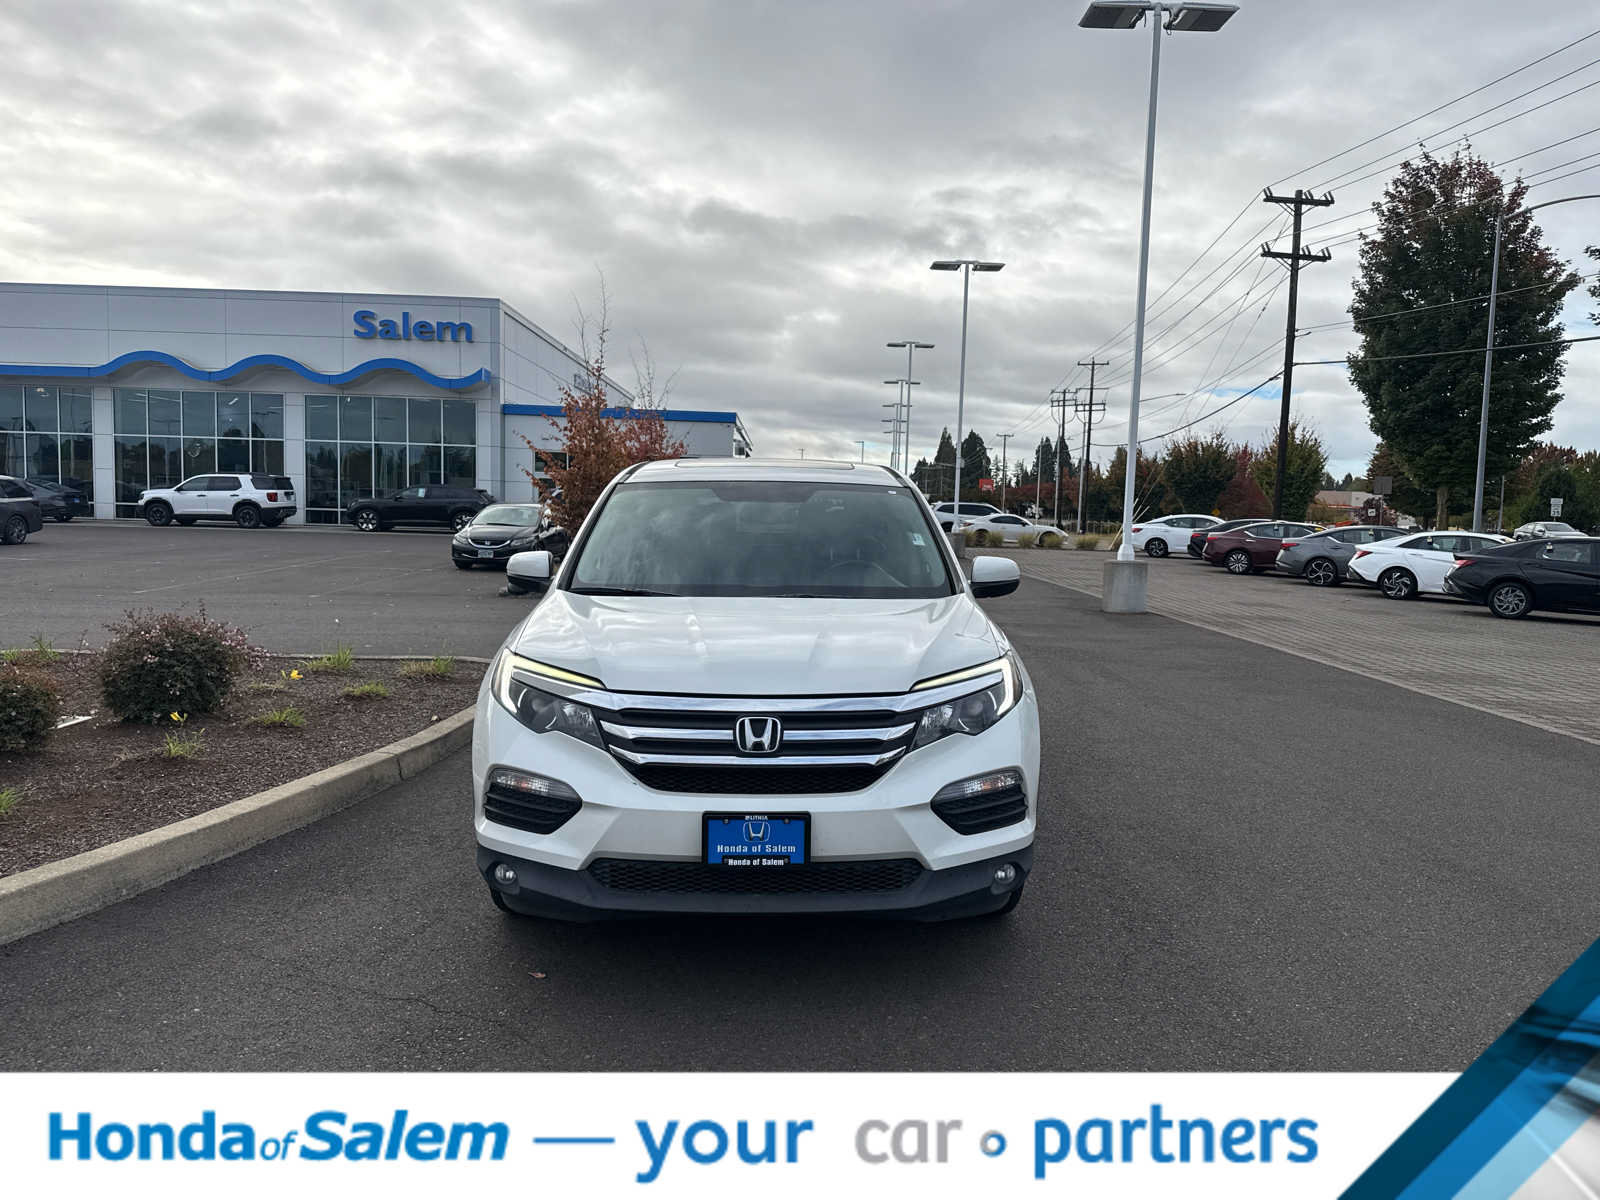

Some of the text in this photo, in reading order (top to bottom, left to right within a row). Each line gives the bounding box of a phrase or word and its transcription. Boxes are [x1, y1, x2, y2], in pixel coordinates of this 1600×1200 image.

[353, 310, 473, 343] Salem
[717, 844, 796, 853] Honda of Salem
[728, 858, 784, 866] Honda of Salem
